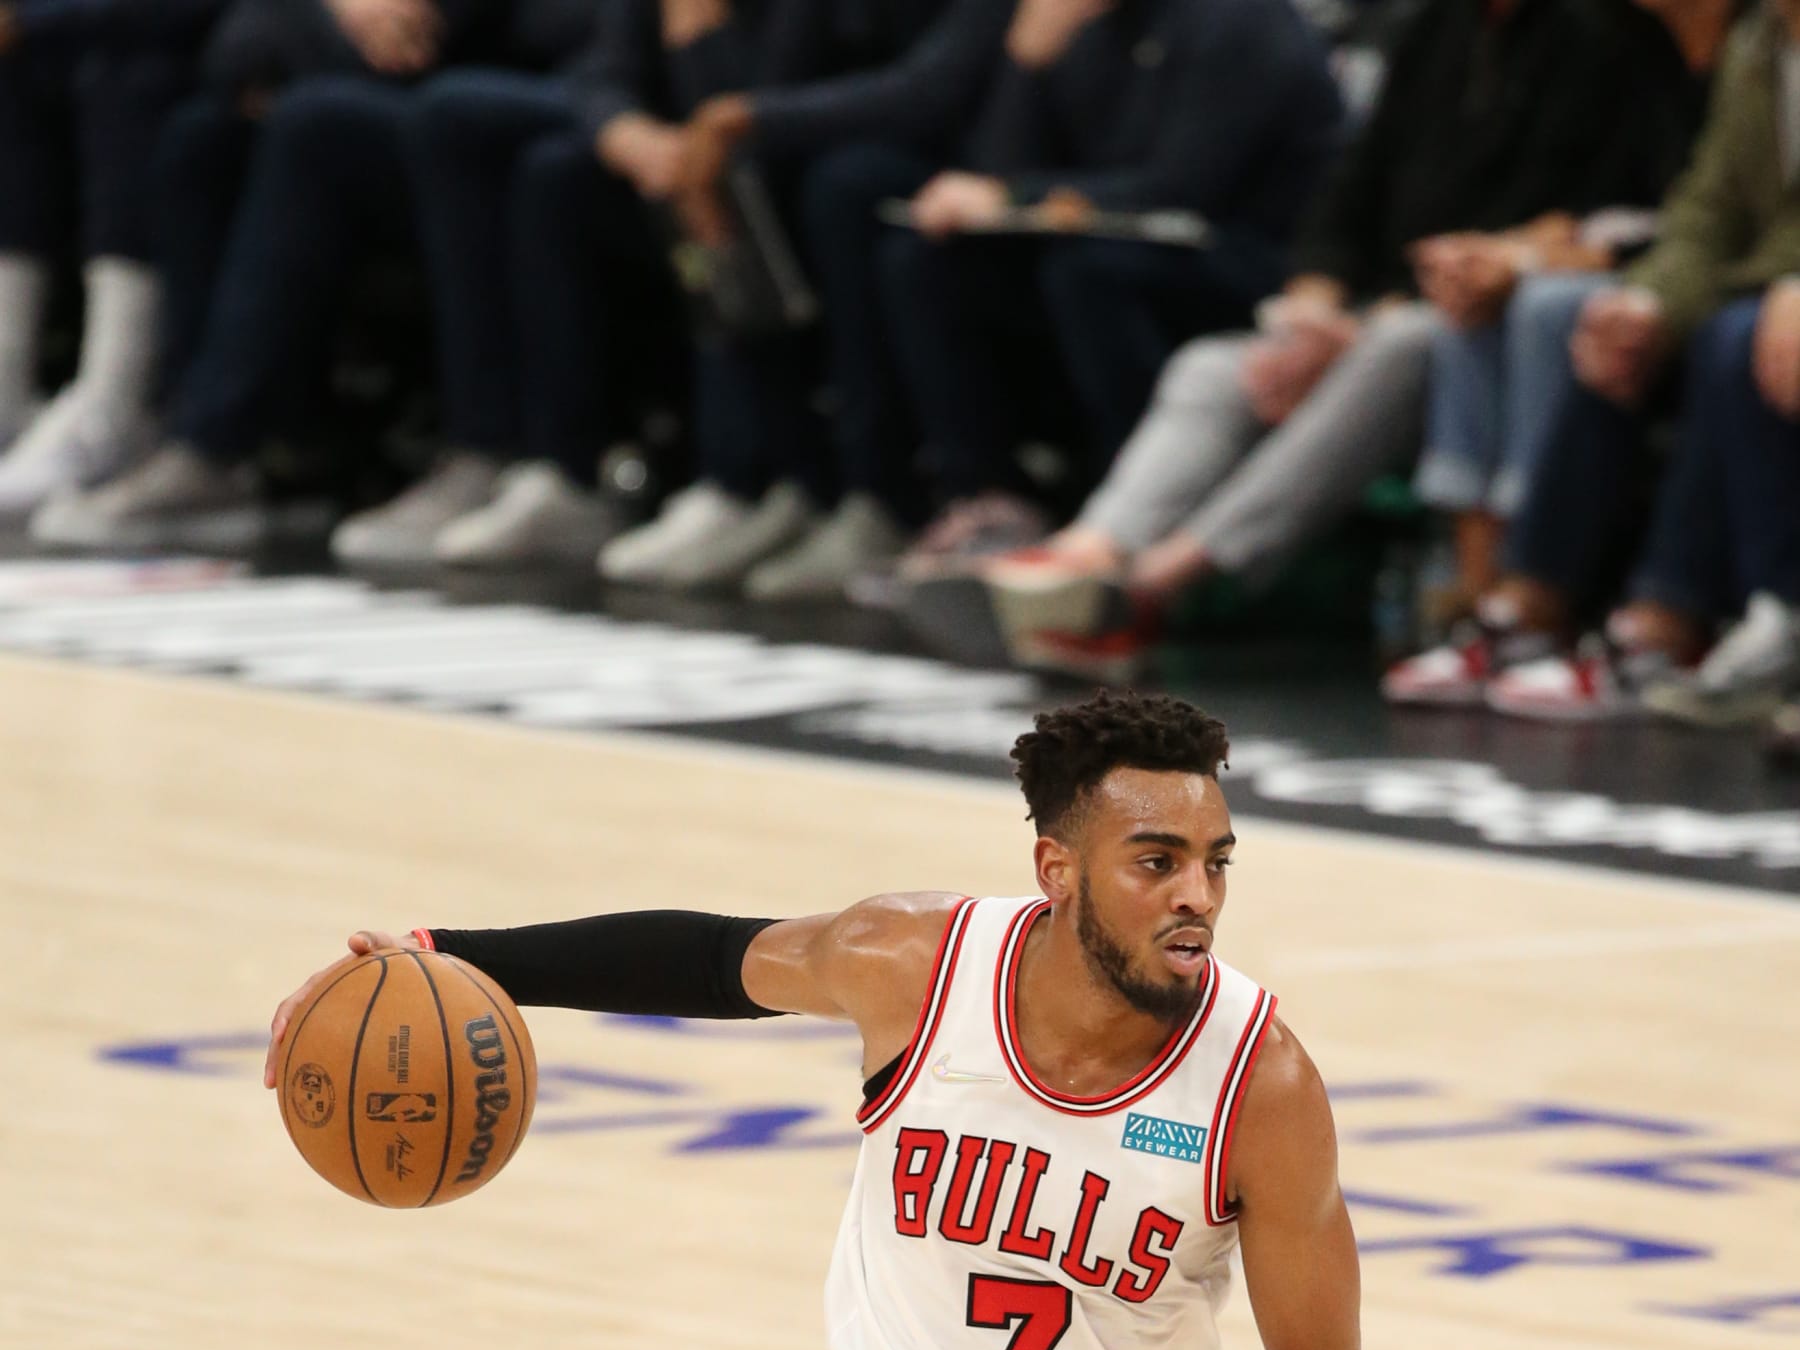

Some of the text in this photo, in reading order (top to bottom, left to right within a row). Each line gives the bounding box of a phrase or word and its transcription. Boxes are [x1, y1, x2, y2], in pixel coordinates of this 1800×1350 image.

[454, 1013, 511, 1184] Wilson
[1124, 1137, 1199, 1161] EYEWEAR
[1128, 1116, 1203, 1147] ZENNI
[892, 1126, 1184, 1303] BULLS
